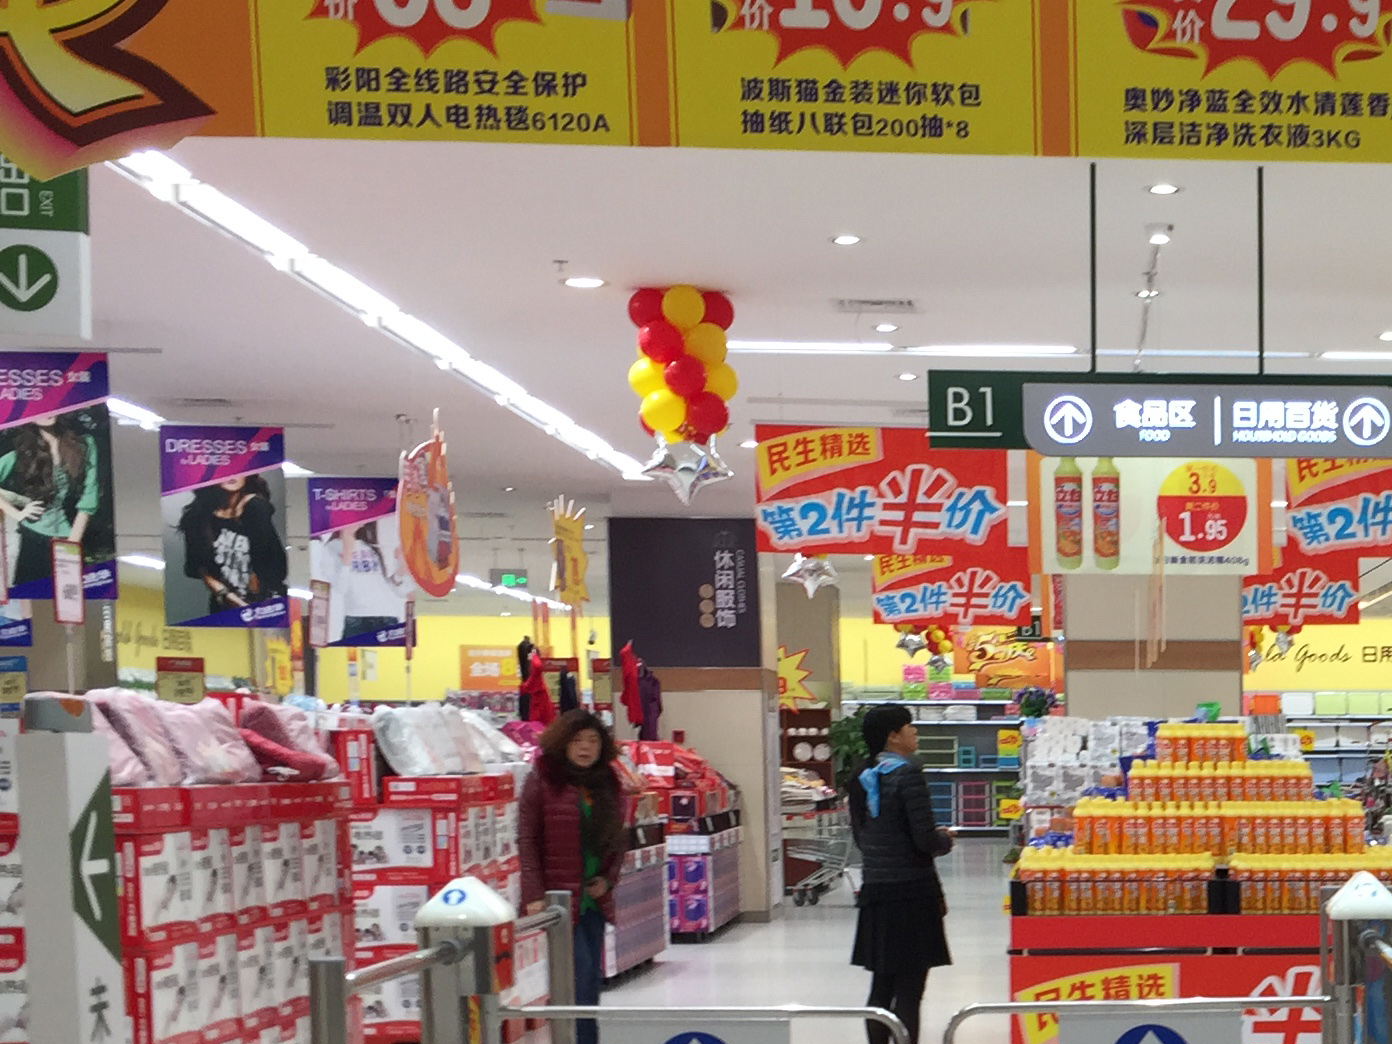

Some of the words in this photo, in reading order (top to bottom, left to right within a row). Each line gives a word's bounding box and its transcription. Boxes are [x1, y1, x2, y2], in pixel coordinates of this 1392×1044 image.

[324, 66, 588, 97] 彩阳全线路安全保护
[740, 77, 982, 107] 波斯猫金装迷你软包
[326, 100, 612, 133] 调温双人电热毯6120A
[1123, 120, 1361, 149] 深层洁净洗衣液3KG
[38, 190, 55, 217] EXIT
[946, 386, 995, 428] B1
[1113, 398, 1197, 430] 食品区
[1232, 400, 1340, 431] 日用百货
[164, 438, 248, 455] DRESSES
[767, 432, 873, 477] 民生精选
[312, 488, 377, 502] T-SHIRTS
[1187, 472, 1218, 495] 3.9
[761, 465, 1001, 553] 第2件半价
[1178, 510, 1229, 542] 1.95
[713, 549, 737, 628] 休闲服饰
[875, 571, 1026, 620] 第2件半价
[1294, 643, 1352, 673] Goods
